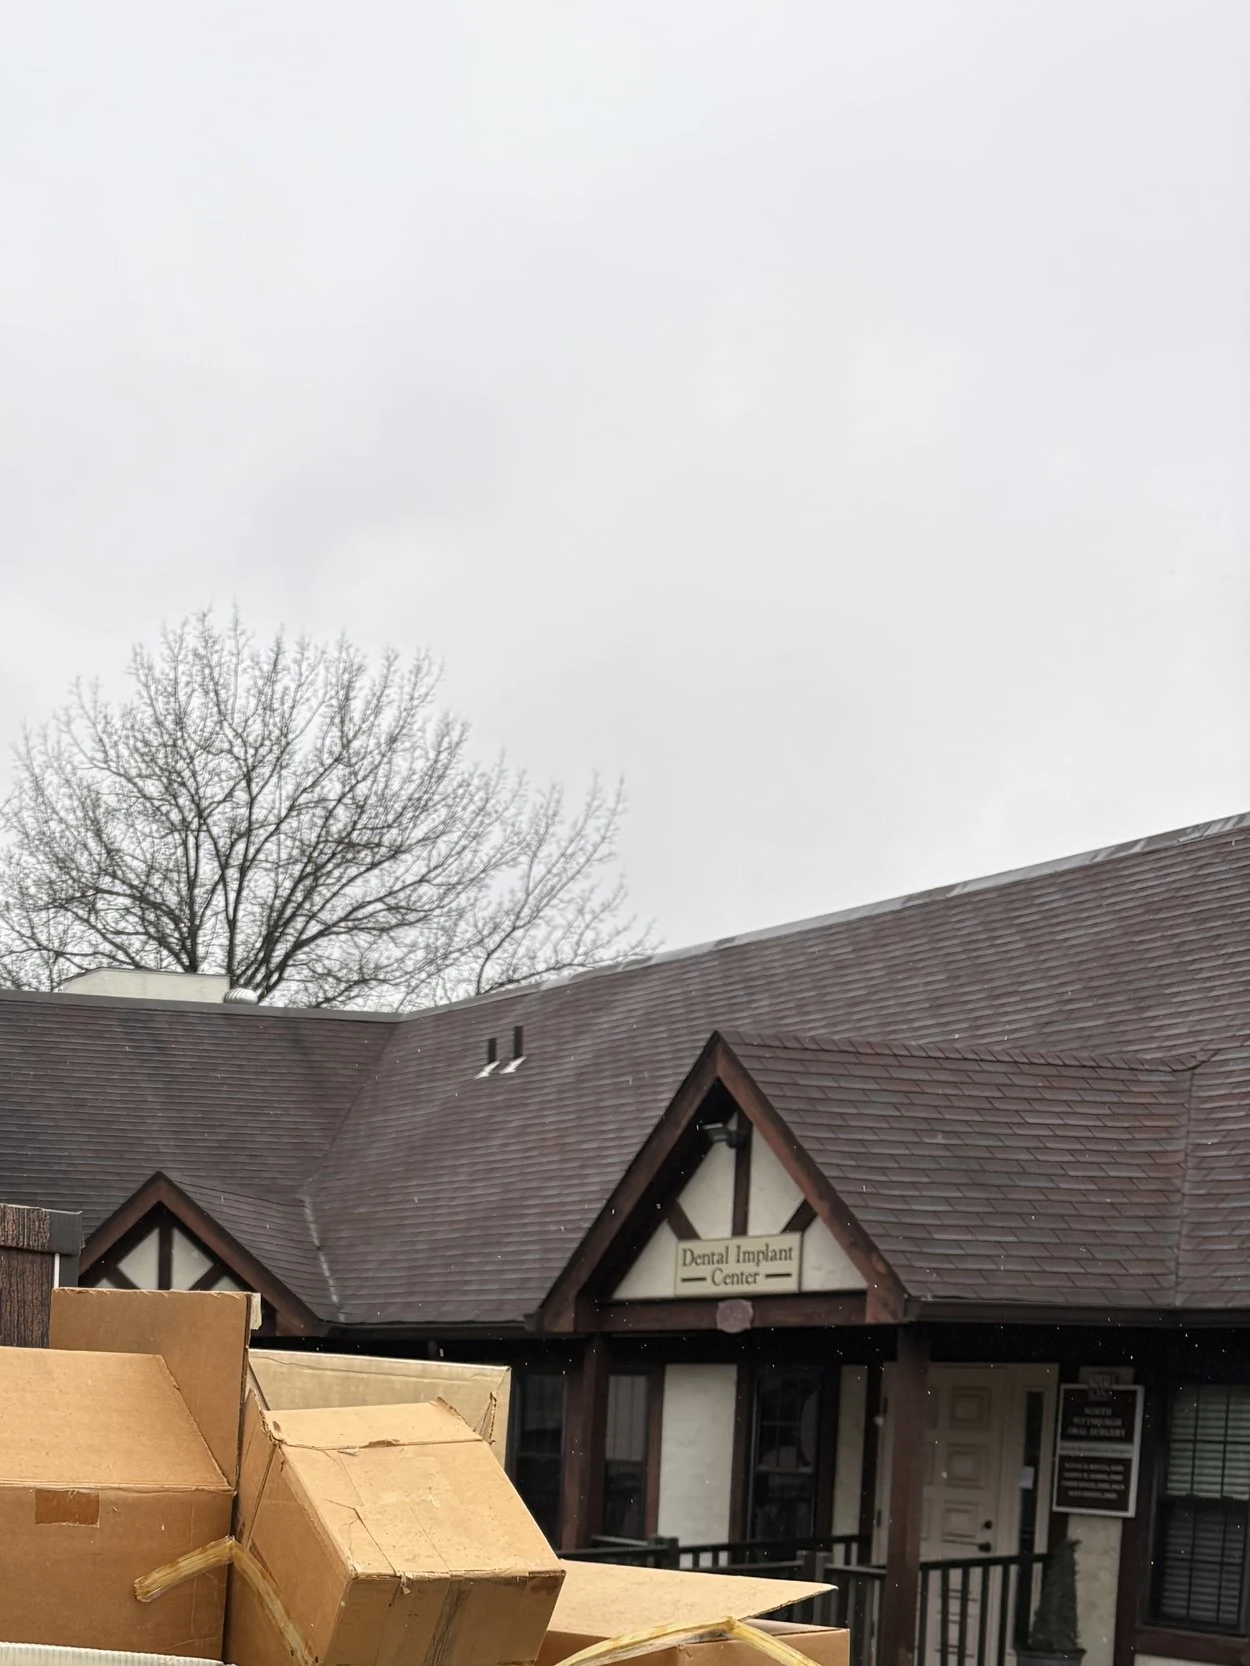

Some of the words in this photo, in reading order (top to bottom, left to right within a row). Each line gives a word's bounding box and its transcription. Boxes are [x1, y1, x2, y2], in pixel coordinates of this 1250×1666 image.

[682, 1245, 729, 1267] Dental
[735, 1243, 793, 1267] Implant
[711, 1267, 760, 1287] Center
